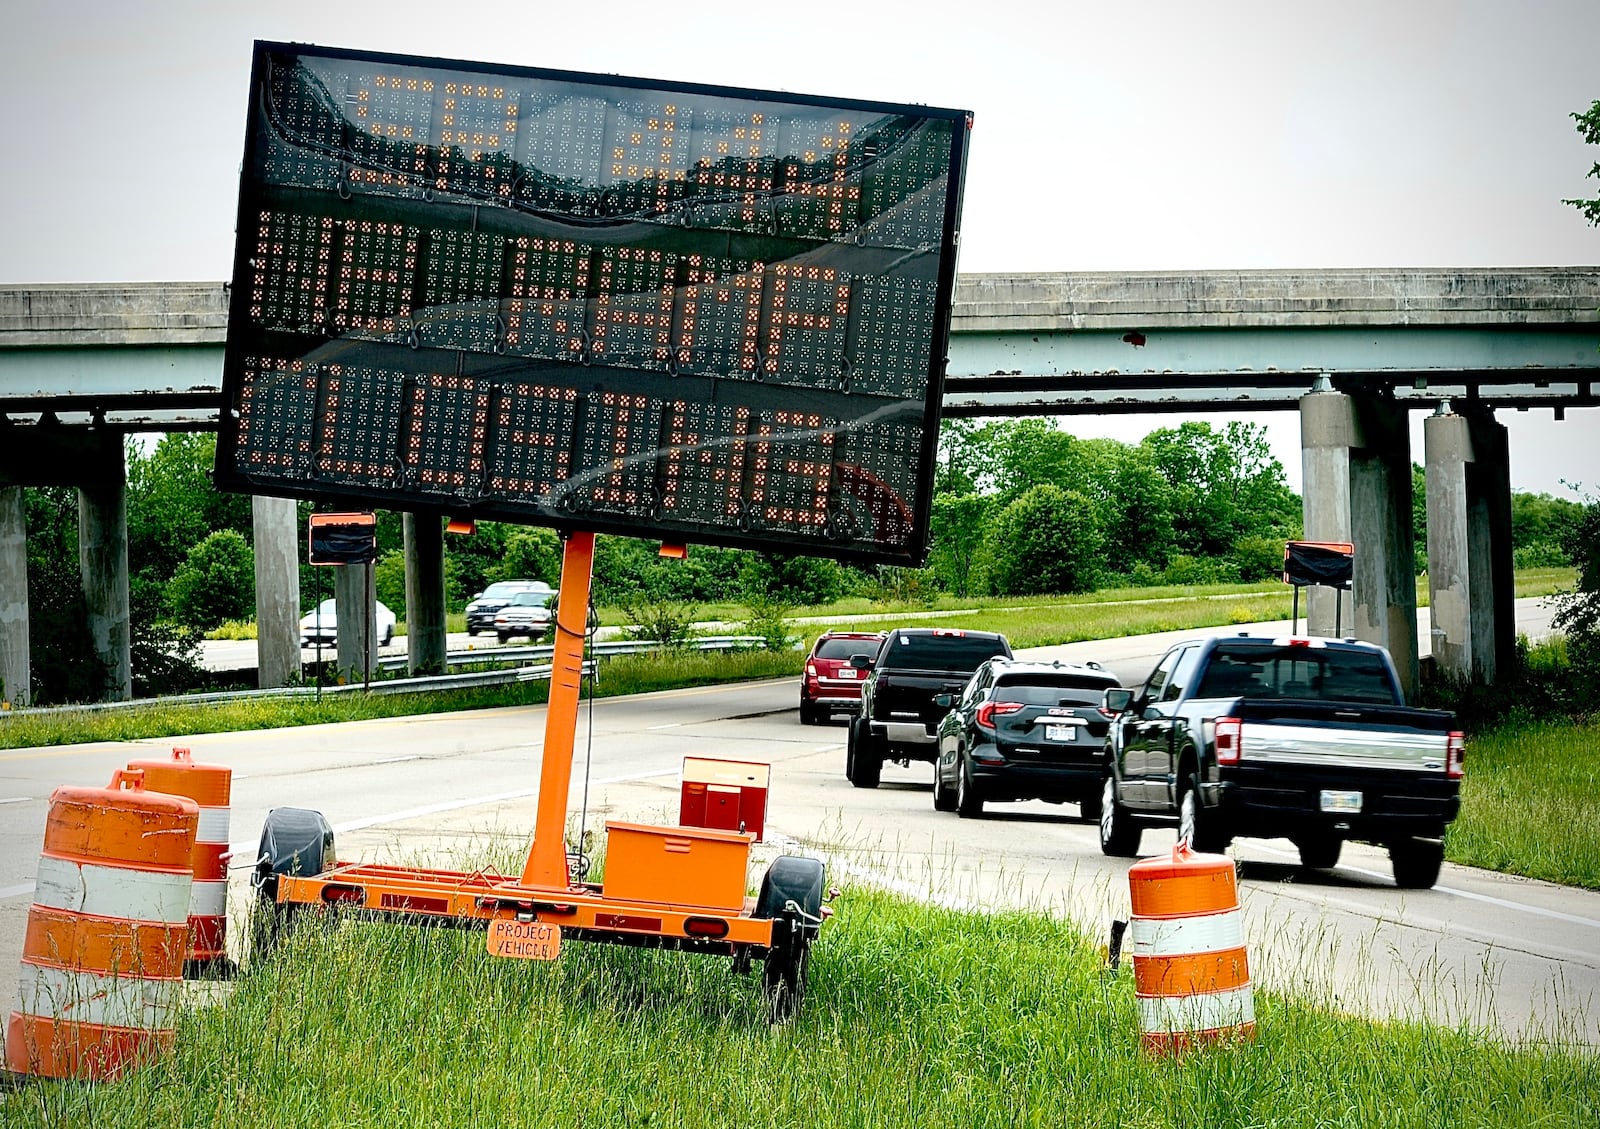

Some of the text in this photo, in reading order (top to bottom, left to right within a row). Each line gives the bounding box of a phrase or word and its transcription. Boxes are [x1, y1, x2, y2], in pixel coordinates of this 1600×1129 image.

[349, 75, 860, 231] SR 444
[250, 210, 849, 372] NB RAMP
[237, 356, 835, 525] CLOSING
[496, 923, 553, 940] PROJECT
[497, 940, 549, 958] VEHICLE
